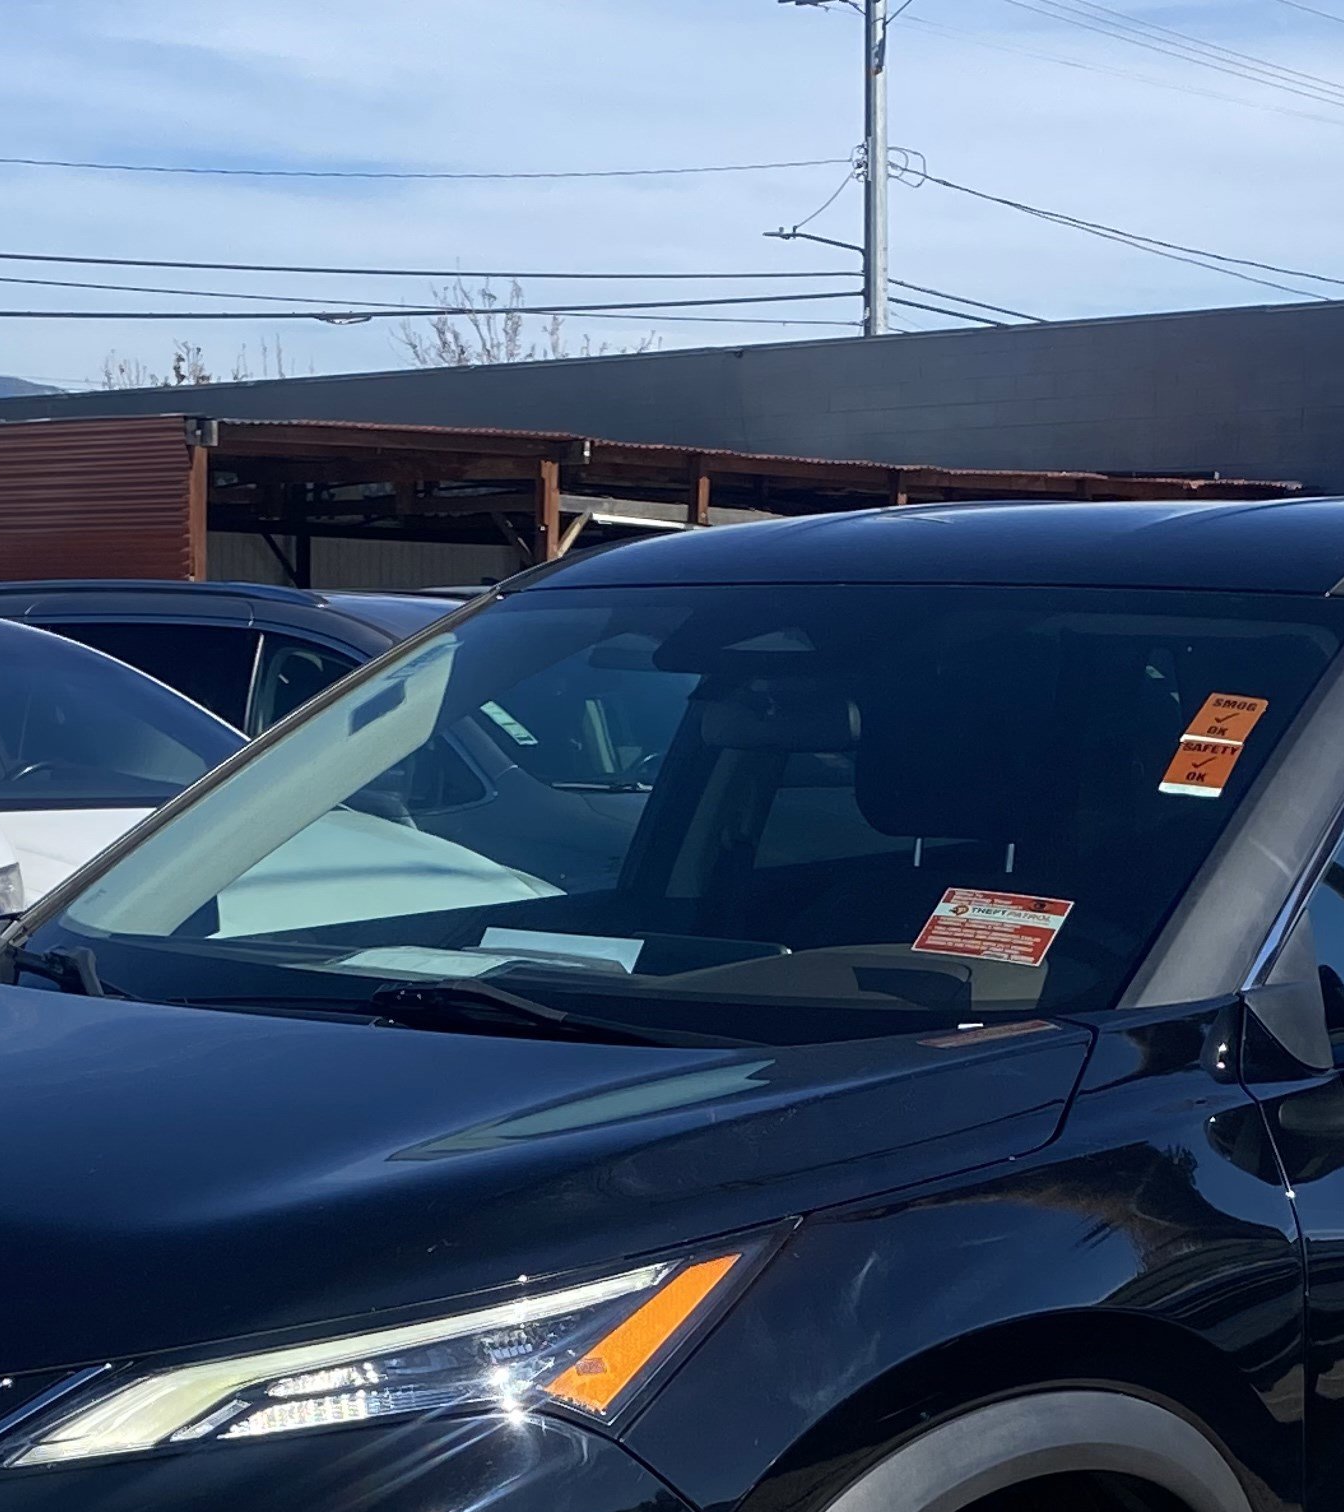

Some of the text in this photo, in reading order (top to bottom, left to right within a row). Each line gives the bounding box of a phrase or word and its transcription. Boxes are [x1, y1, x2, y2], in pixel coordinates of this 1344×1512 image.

[1212, 698, 1258, 712] SMOG
[1206, 725, 1229, 737] OK
[1182, 742, 1241, 757] SAFETY
[1184, 770, 1208, 783] OK
[971, 906, 1008, 918] THEFT
